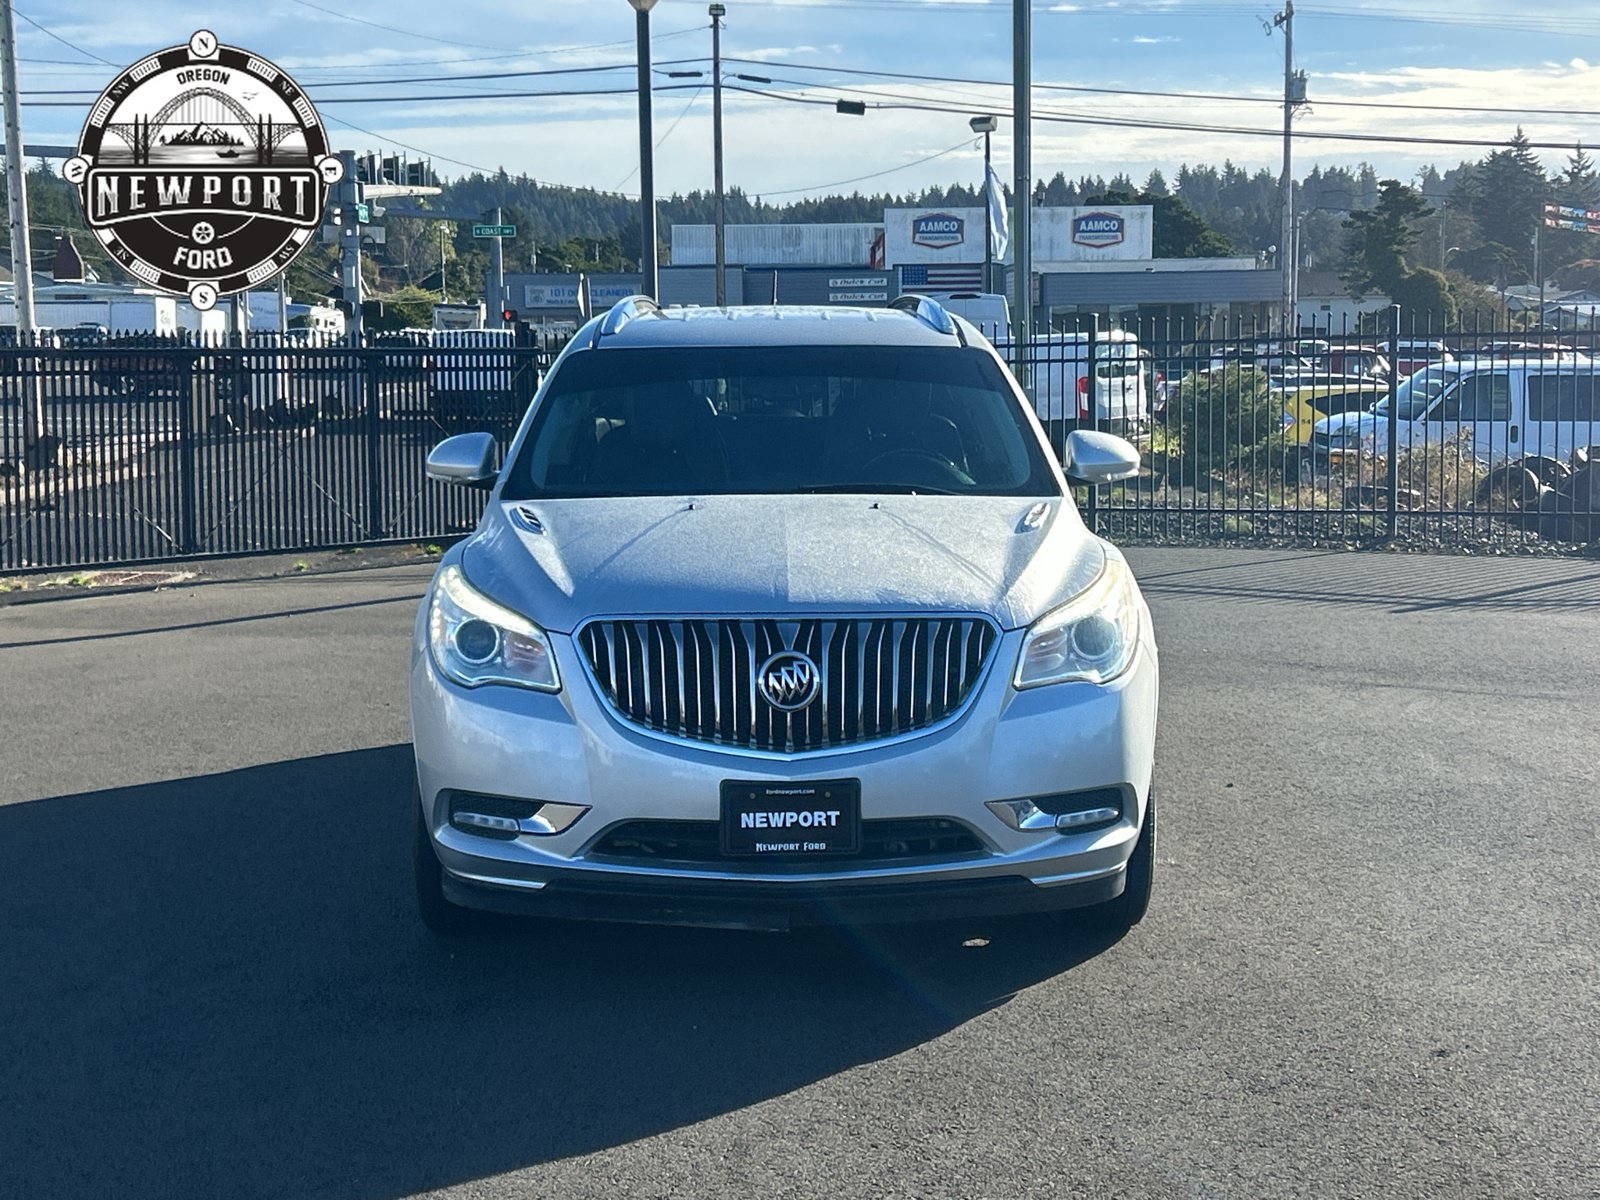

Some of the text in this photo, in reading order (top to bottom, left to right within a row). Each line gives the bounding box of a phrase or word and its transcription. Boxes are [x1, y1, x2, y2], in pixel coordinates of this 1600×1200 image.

[481, 227, 502, 235] COAST
[919, 221, 958, 232] AAMCO
[1079, 220, 1118, 231] AAMCO
[741, 810, 840, 828] NEWPORT
